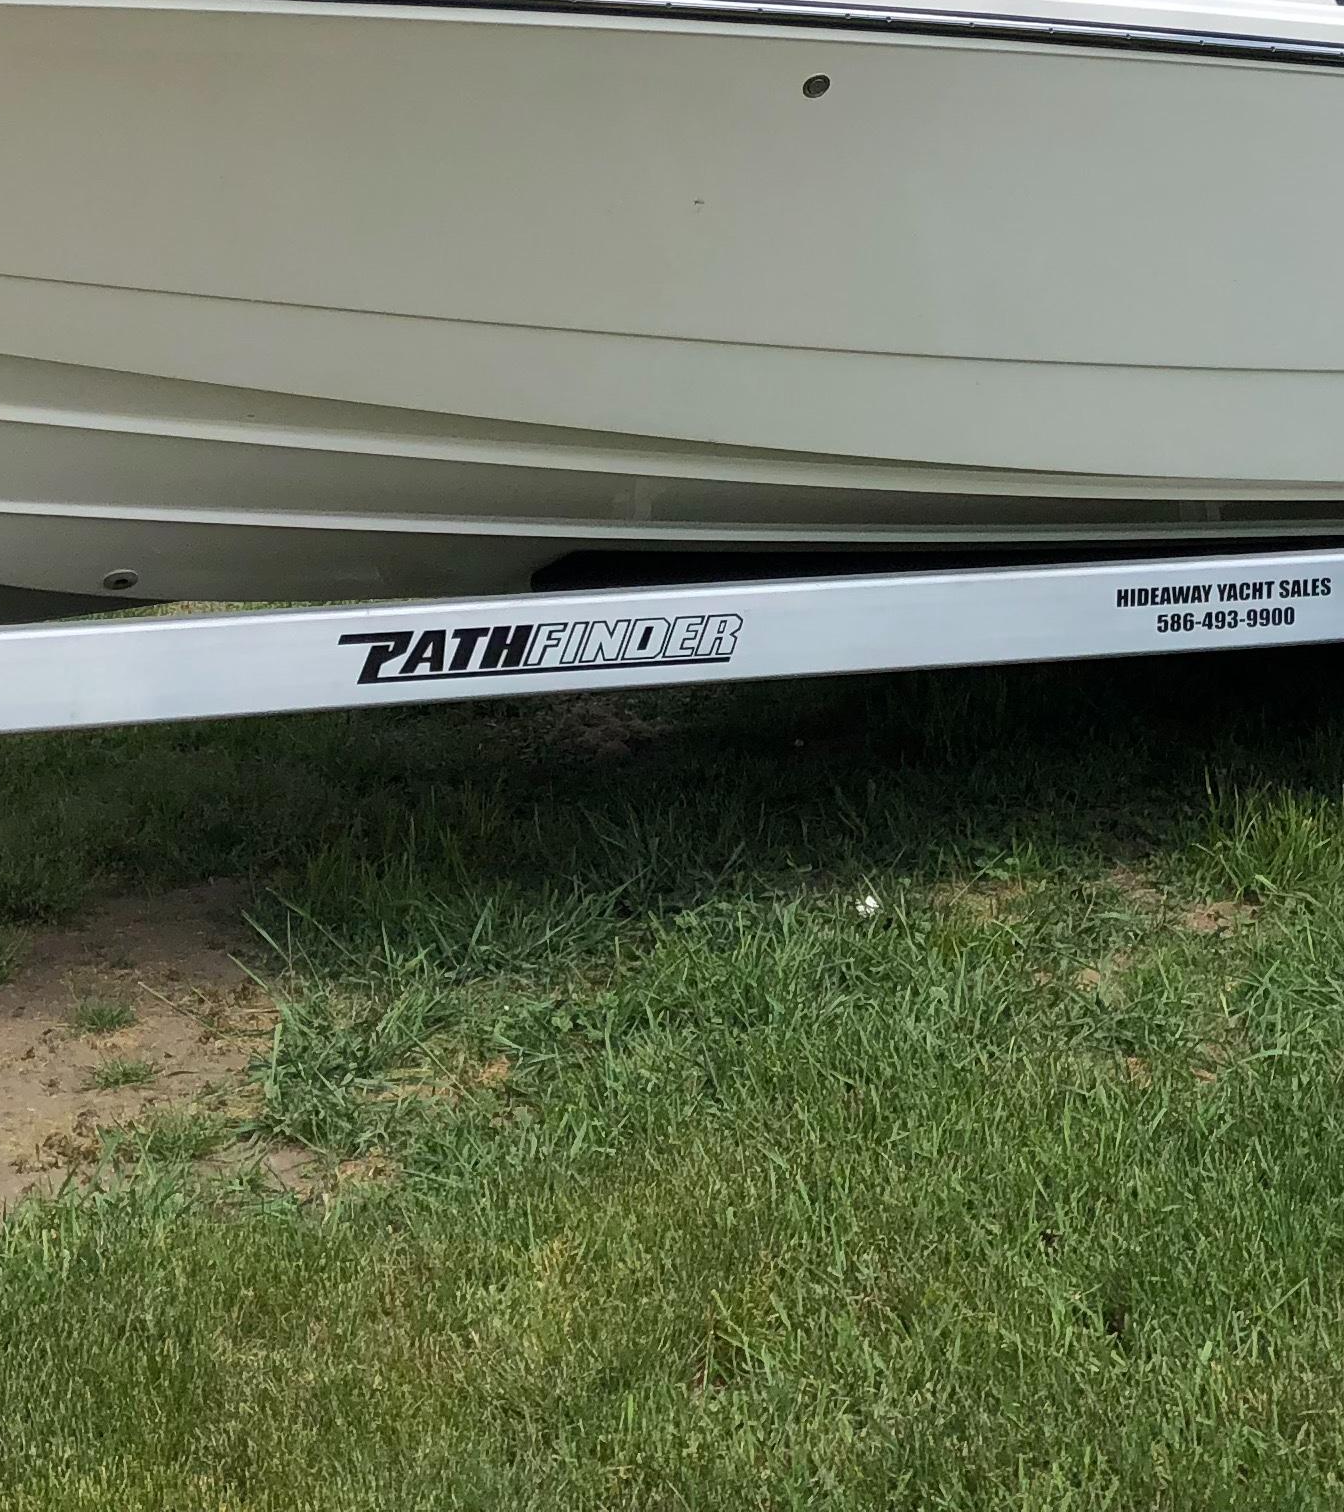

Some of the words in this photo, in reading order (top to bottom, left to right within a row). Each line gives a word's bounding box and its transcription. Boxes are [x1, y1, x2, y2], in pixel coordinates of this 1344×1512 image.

[1117, 584, 1213, 608] HIDEAWAY
[1217, 581, 1275, 602] YACHT
[1279, 577, 1332, 599] SALES
[1157, 606, 1295, 633] 586-493-9900
[338, 613, 743, 685] PATHFINDER
